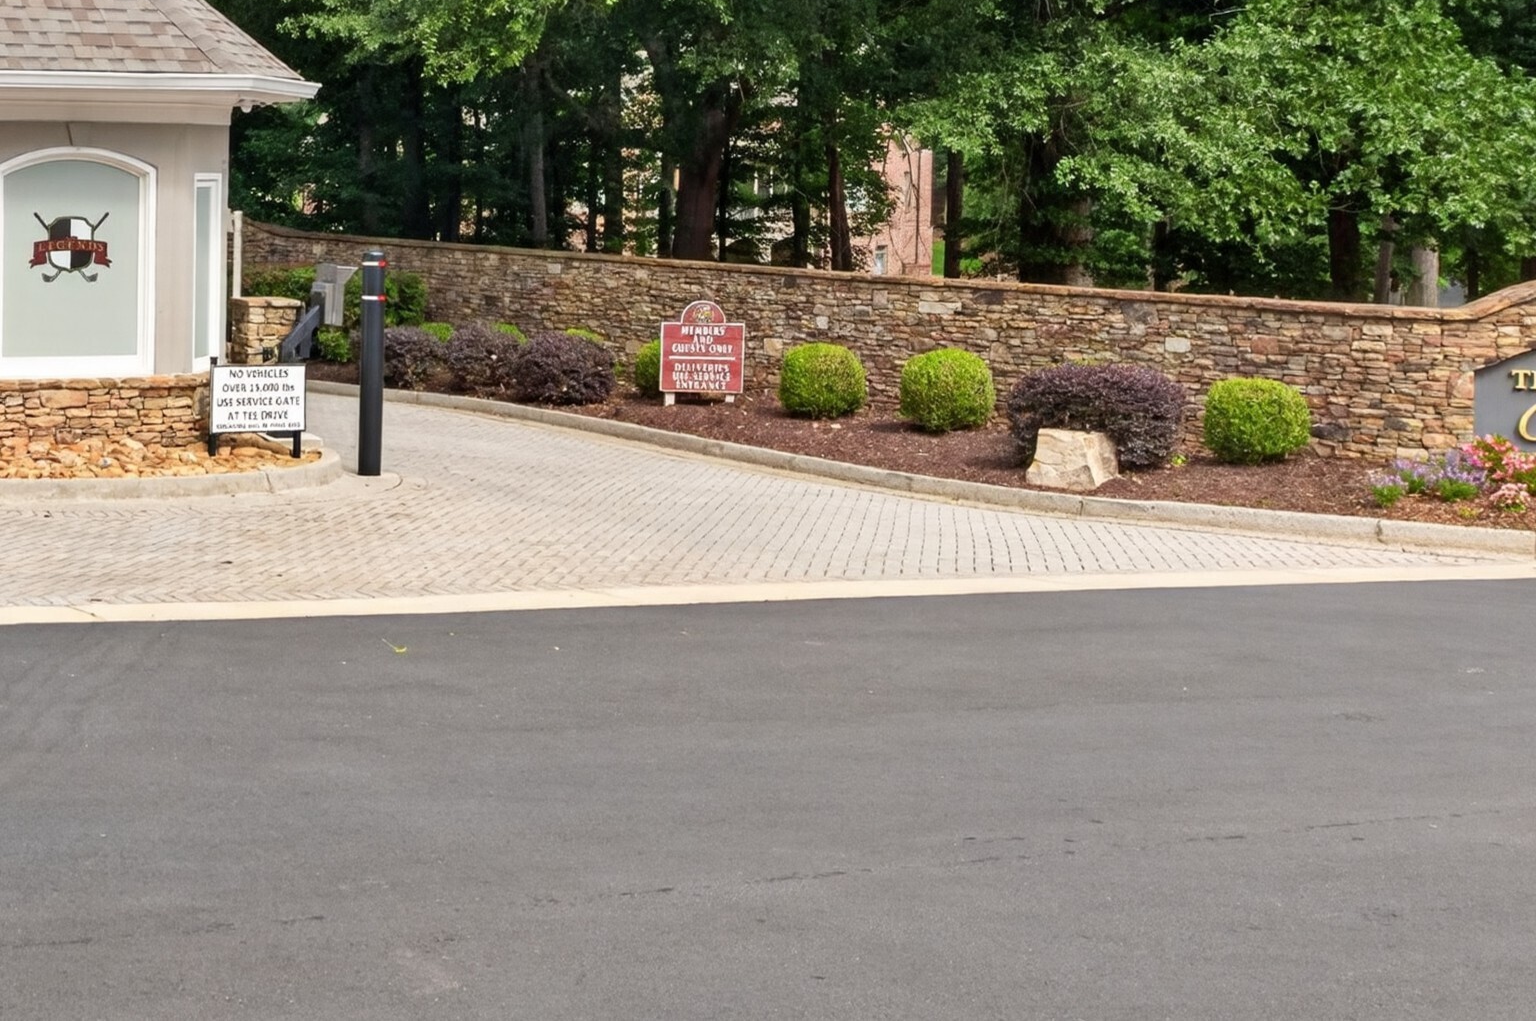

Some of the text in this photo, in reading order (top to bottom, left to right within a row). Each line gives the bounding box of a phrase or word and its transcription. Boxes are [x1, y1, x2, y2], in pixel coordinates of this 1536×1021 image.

[38, 240, 104, 252] LEGENDS
[681, 326, 726, 335] MEMBERS
[693, 335, 713, 345] AND
[672, 343, 733, 353] GUESTS ONLY
[674, 363, 729, 372] DELIVERIES
[229, 368, 289, 378] NO VEHICLES
[692, 371, 731, 381] SERVICE
[222, 383, 247, 392] OVER
[675, 380, 726, 390] ENTRANCE
[216, 396, 300, 407] USE SERVICE GATE
[227, 411, 239, 420] AT
[261, 410, 289, 420] DRIVE
